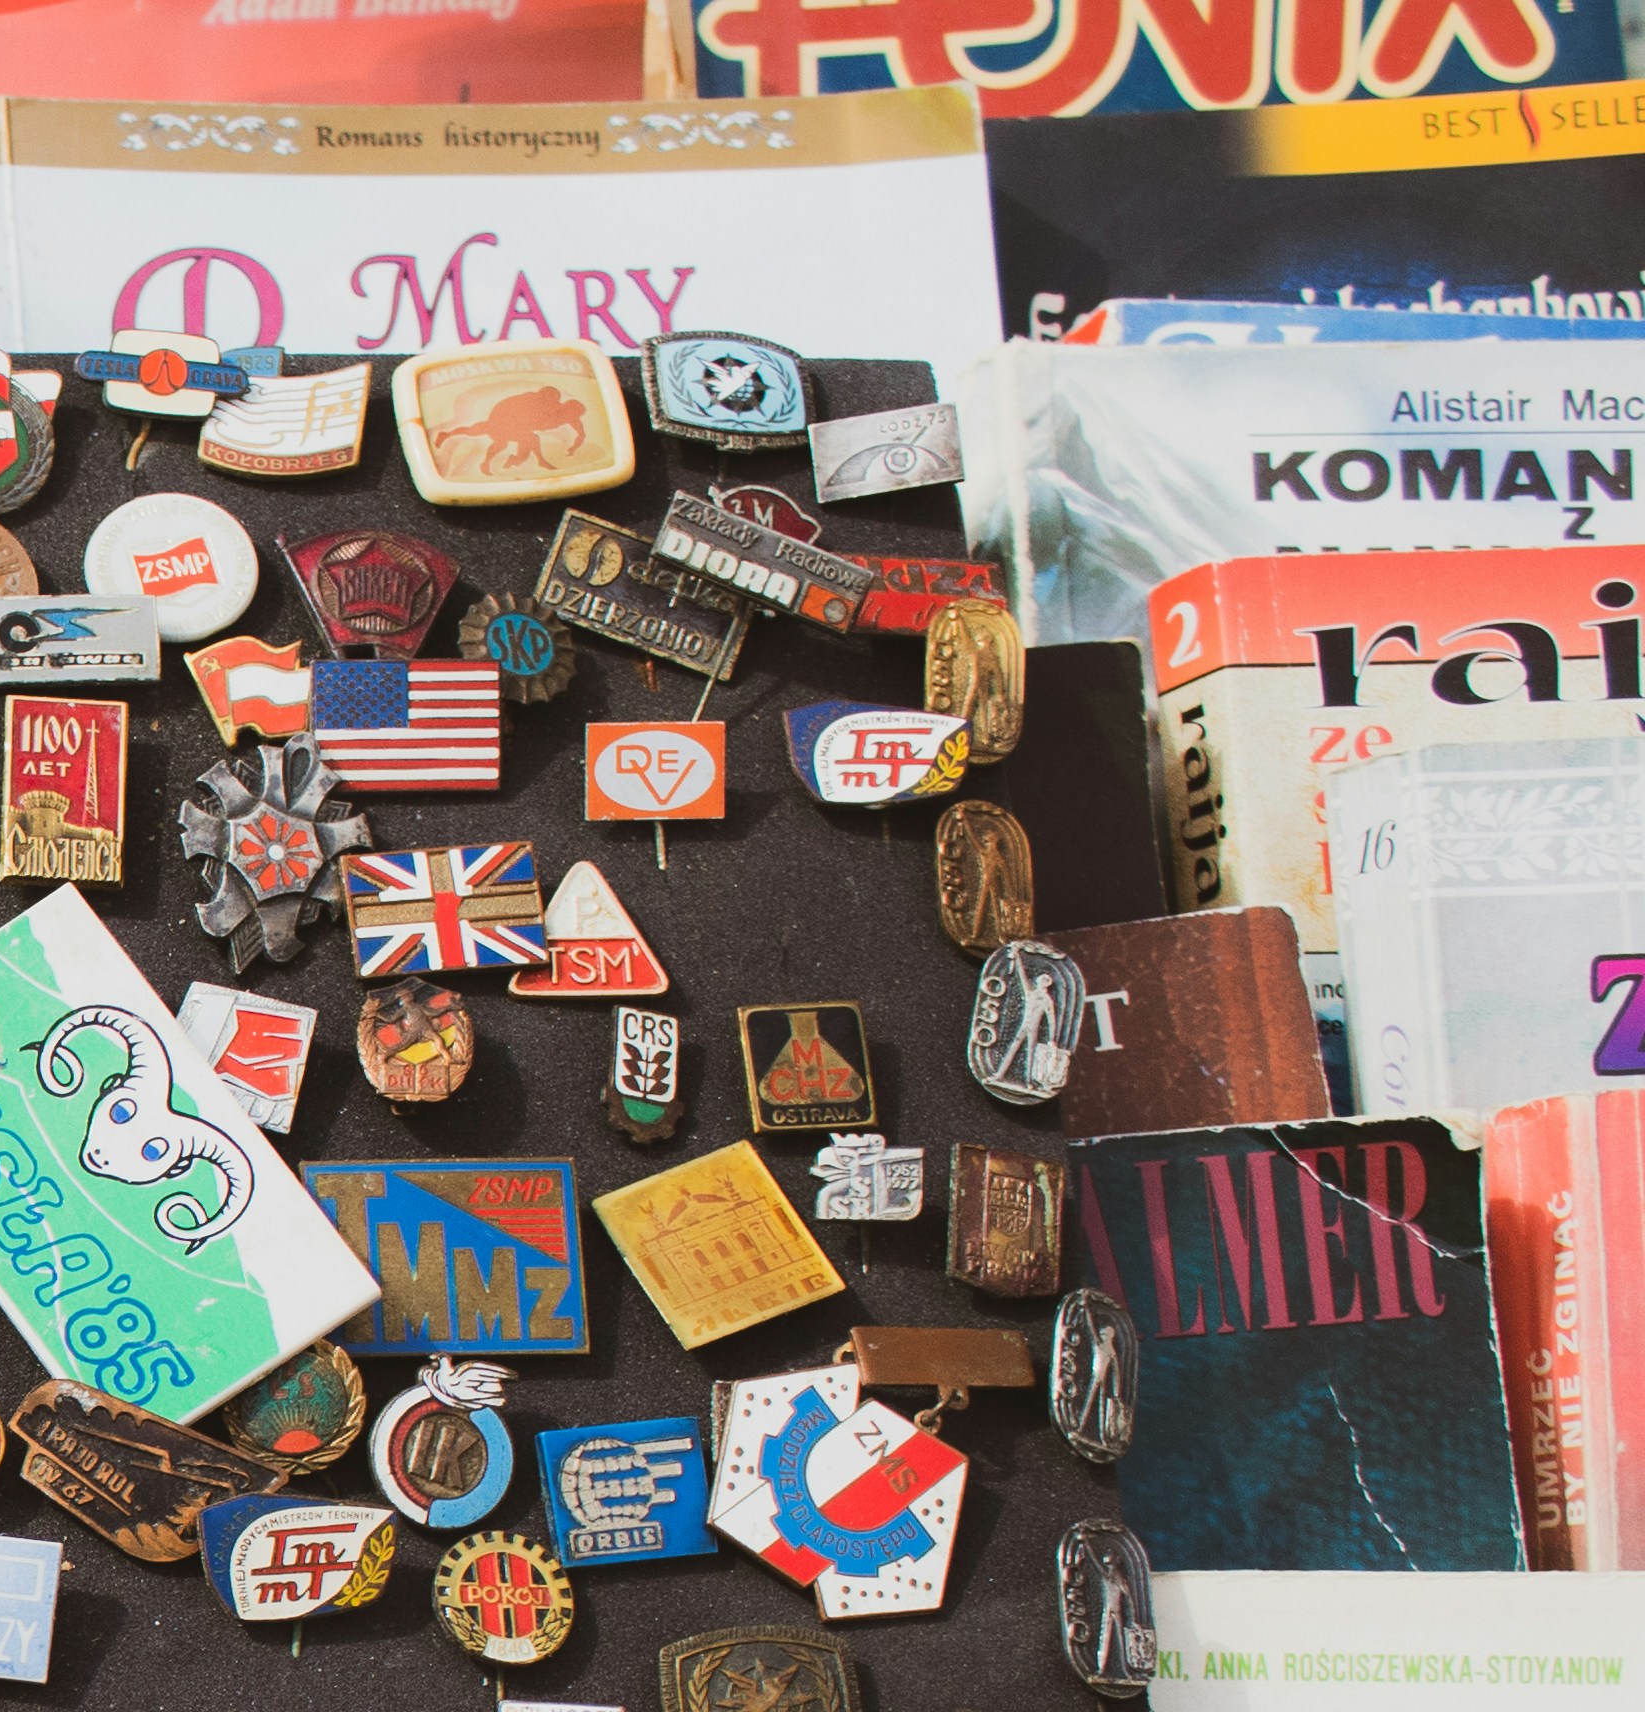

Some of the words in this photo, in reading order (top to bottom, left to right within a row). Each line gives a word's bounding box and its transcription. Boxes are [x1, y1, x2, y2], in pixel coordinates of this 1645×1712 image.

[315, 124, 424, 150] Romans
[443, 120, 601, 157] historyczny
[1422, 107, 1507, 141] BEST
[350, 231, 697, 351] MARY
[1390, 390, 1533, 425] Alistair
[206, 444, 353, 471] KOŁOBRZEG
[659, 530, 799, 604] DIORA
[493, 624, 551, 670] SKP
[1166, 601, 1203, 669] 2
[20, 714, 83, 754] 1100
[1308, 723, 1394, 765] ze
[22, 758, 73, 776] ЛЕТ
[1356, 818, 1397, 876] 16
[622, 1011, 674, 1044] CRS
[772, 1107, 861, 1125] OSTRAVA
[1550, 1187, 1579, 1355] ZGINĄĆ
[1557, 1373, 1582, 1449] NIE
[855, 1421, 918, 1494] ZMS
[1529, 1347, 1561, 1531] UMRZEĆ
[1562, 1468, 1586, 1525] BY
[574, 1525, 657, 1554] ORBIS
[466, 1584, 545, 1606] POKÓJ
[1203, 1652, 1269, 1681] ANNA
[1284, 1650, 1624, 1686] ROŚCISZEWSKA-STOYANOW
